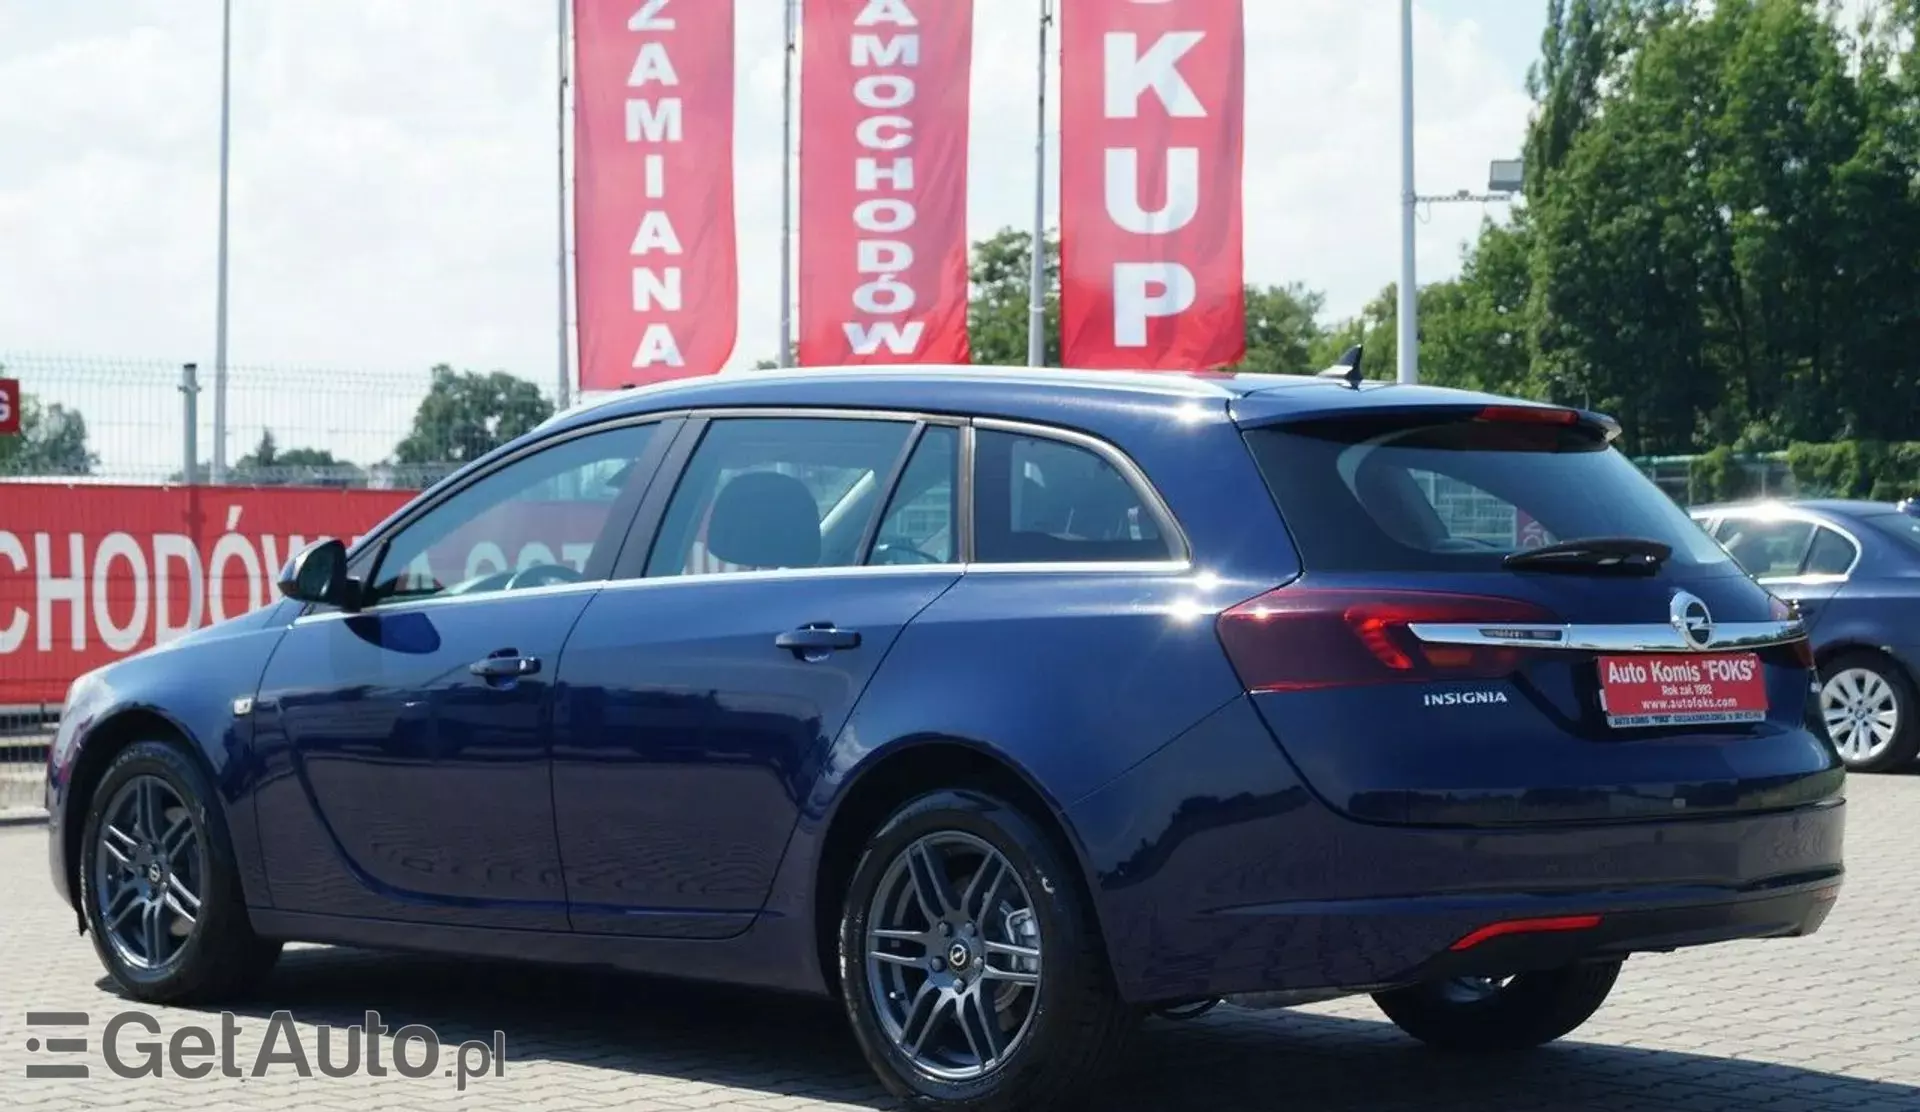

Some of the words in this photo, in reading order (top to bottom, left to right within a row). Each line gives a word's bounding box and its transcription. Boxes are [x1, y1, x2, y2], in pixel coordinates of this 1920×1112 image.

[625, 0, 685, 367] ZAMIANA
[1103, 0, 1208, 347] KUP
[1608, 661, 1647, 684] Auto
[1650, 661, 1700, 682] Komis
[1424, 691, 1508, 706] INSIGNIA
[1641, 697, 1737, 710] www.autofoks.com
